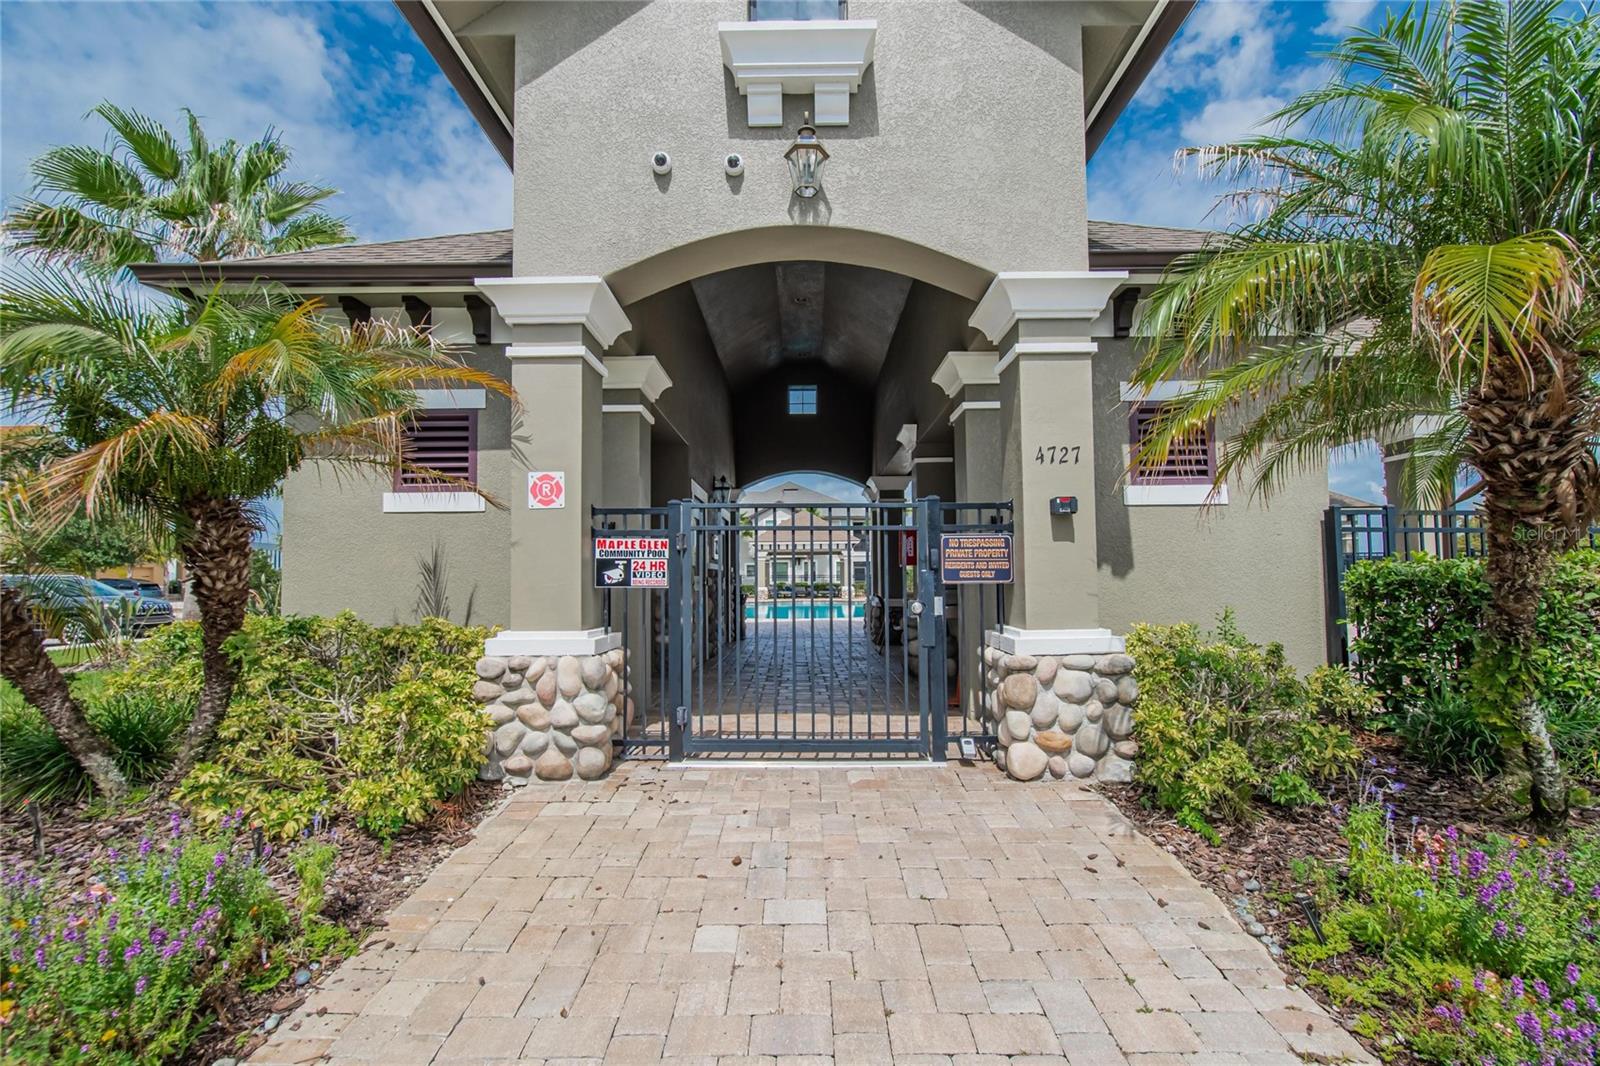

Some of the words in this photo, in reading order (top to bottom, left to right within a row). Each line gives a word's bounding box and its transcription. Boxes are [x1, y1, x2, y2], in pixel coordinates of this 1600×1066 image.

[1035, 446, 1080, 465] 4727
[542, 483, 551, 496] R
[597, 539, 636, 550] MAPLE
[639, 539, 668, 550] GLEN
[948, 538, 959, 547] NO
[960, 538, 1005, 548] TRESPASSING
[599, 549, 645, 558] COMMUNITY
[647, 549, 666, 558] POOL
[945, 548, 973, 558] PRIVATE
[974, 548, 1009, 558] PROPERTY
[633, 560, 646, 571] 24
[650, 560, 666, 571] HR
[944, 561, 974, 569] RESIDENTS
[975, 561, 988, 569] AND
[959, 570, 980, 578] GUESTS
[981, 570, 996, 578] ONLY
